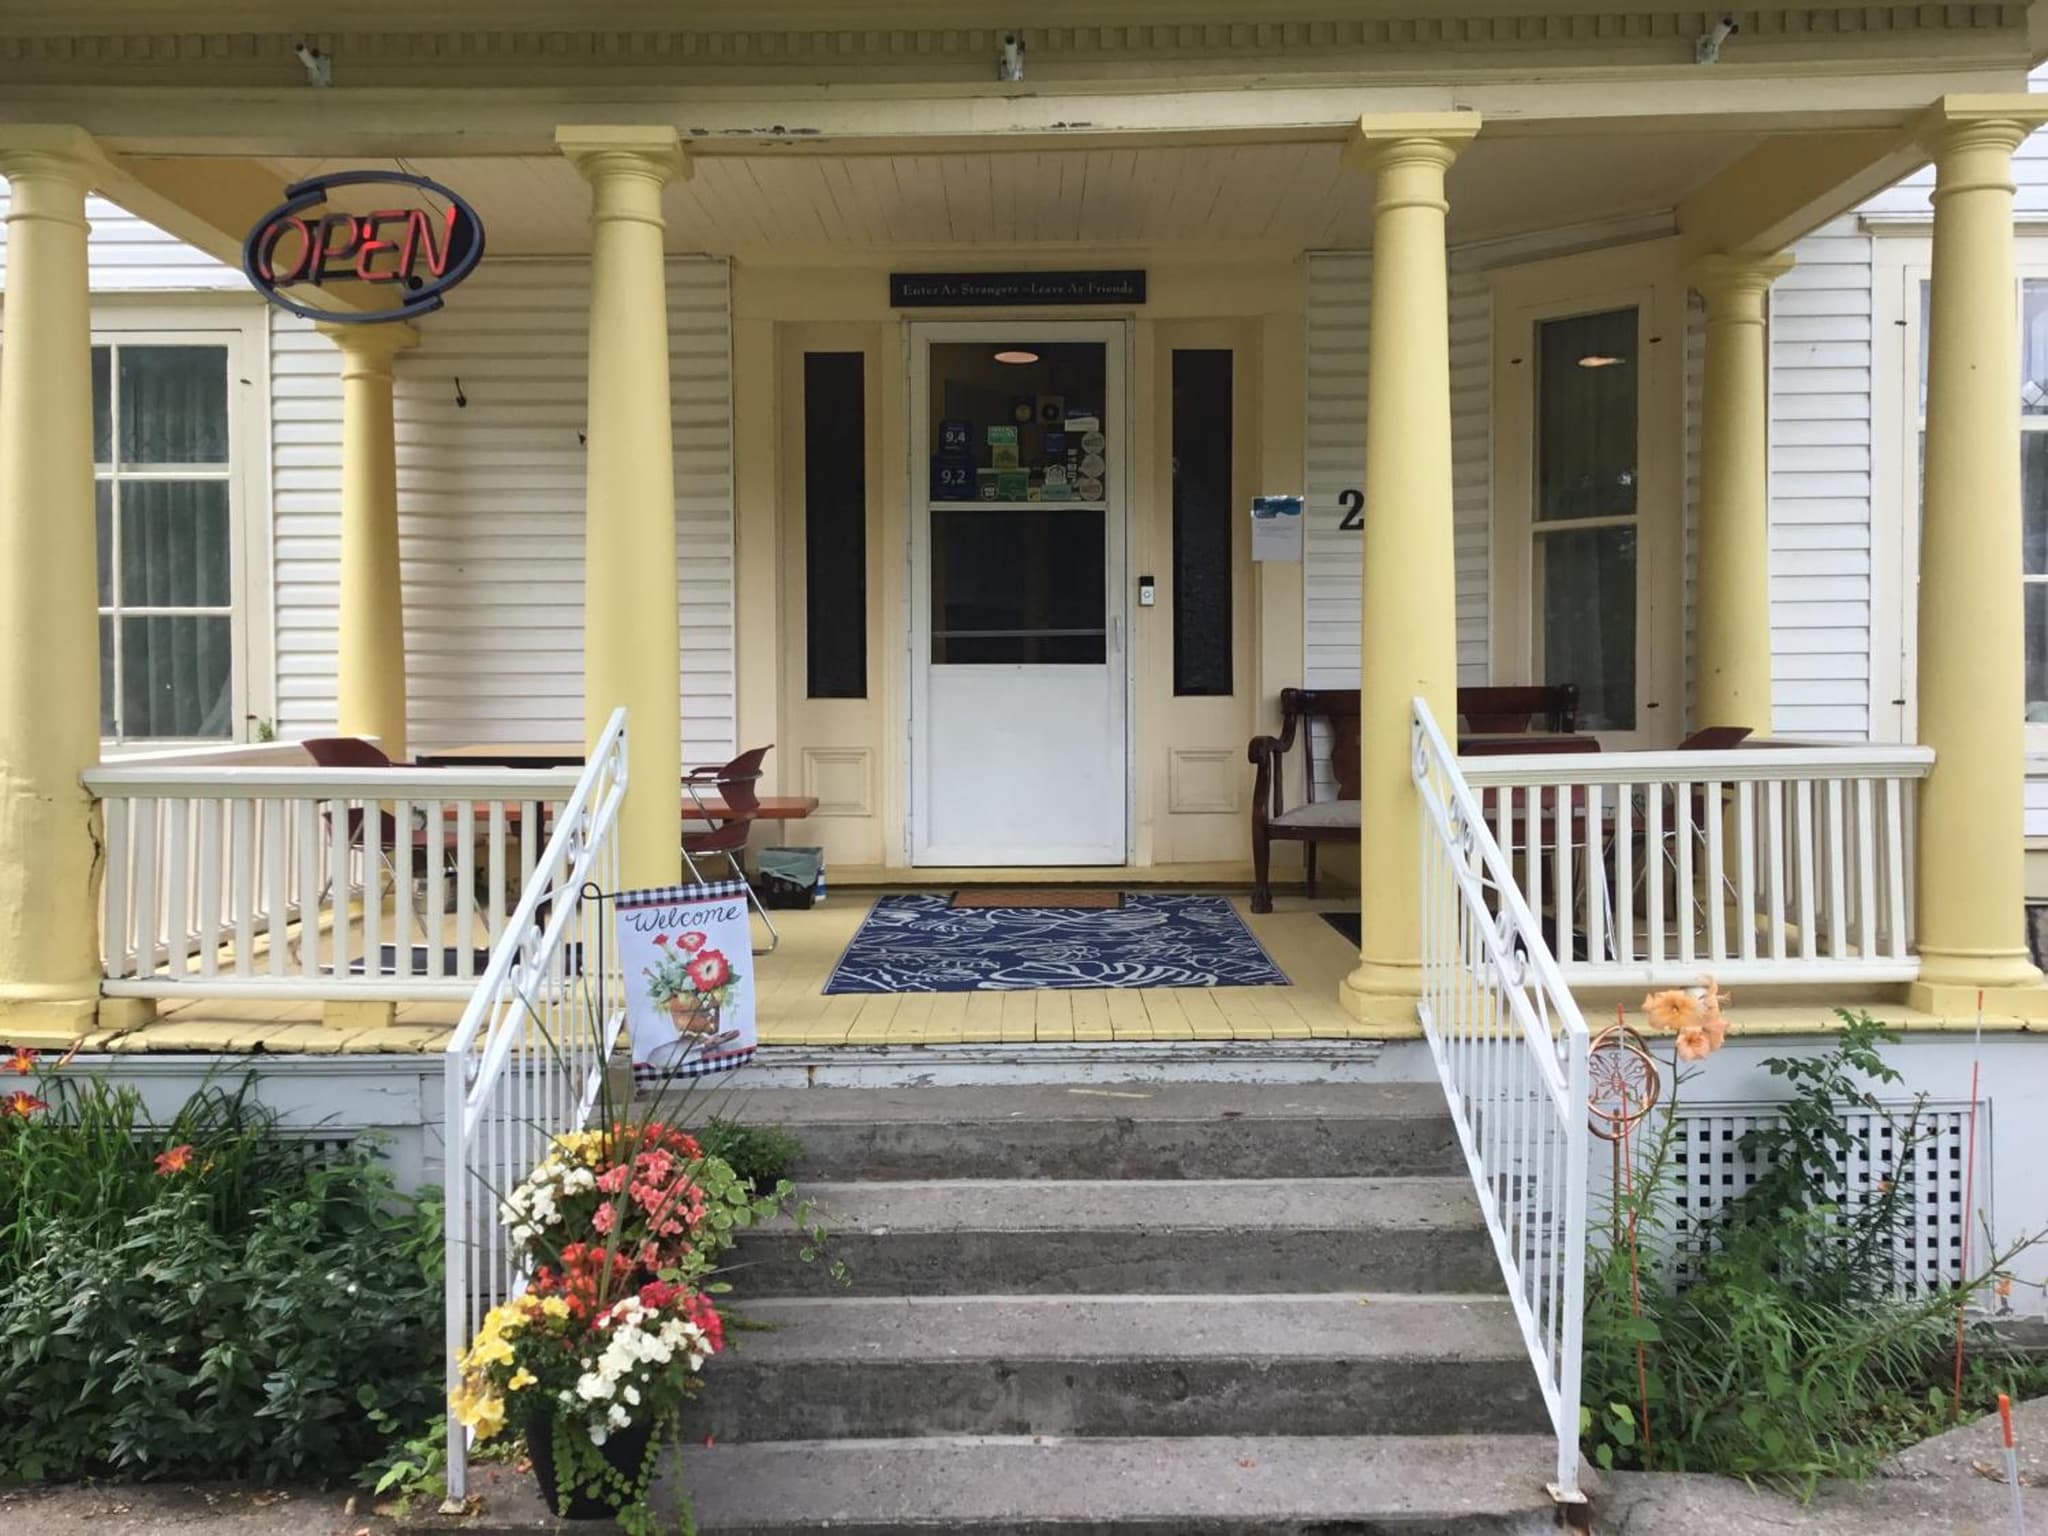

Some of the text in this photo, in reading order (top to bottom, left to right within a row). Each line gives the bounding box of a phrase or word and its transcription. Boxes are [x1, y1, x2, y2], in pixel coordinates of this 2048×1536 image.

[257, 204, 457, 288] OPEN
[903, 283, 938, 296] Enter
[961, 282, 1018, 296] Strangers
[1031, 281, 1064, 294] Leave
[1088, 280, 1133, 294] Friends
[1338, 489, 1365, 530] 2
[625, 905, 742, 932] Welcome
